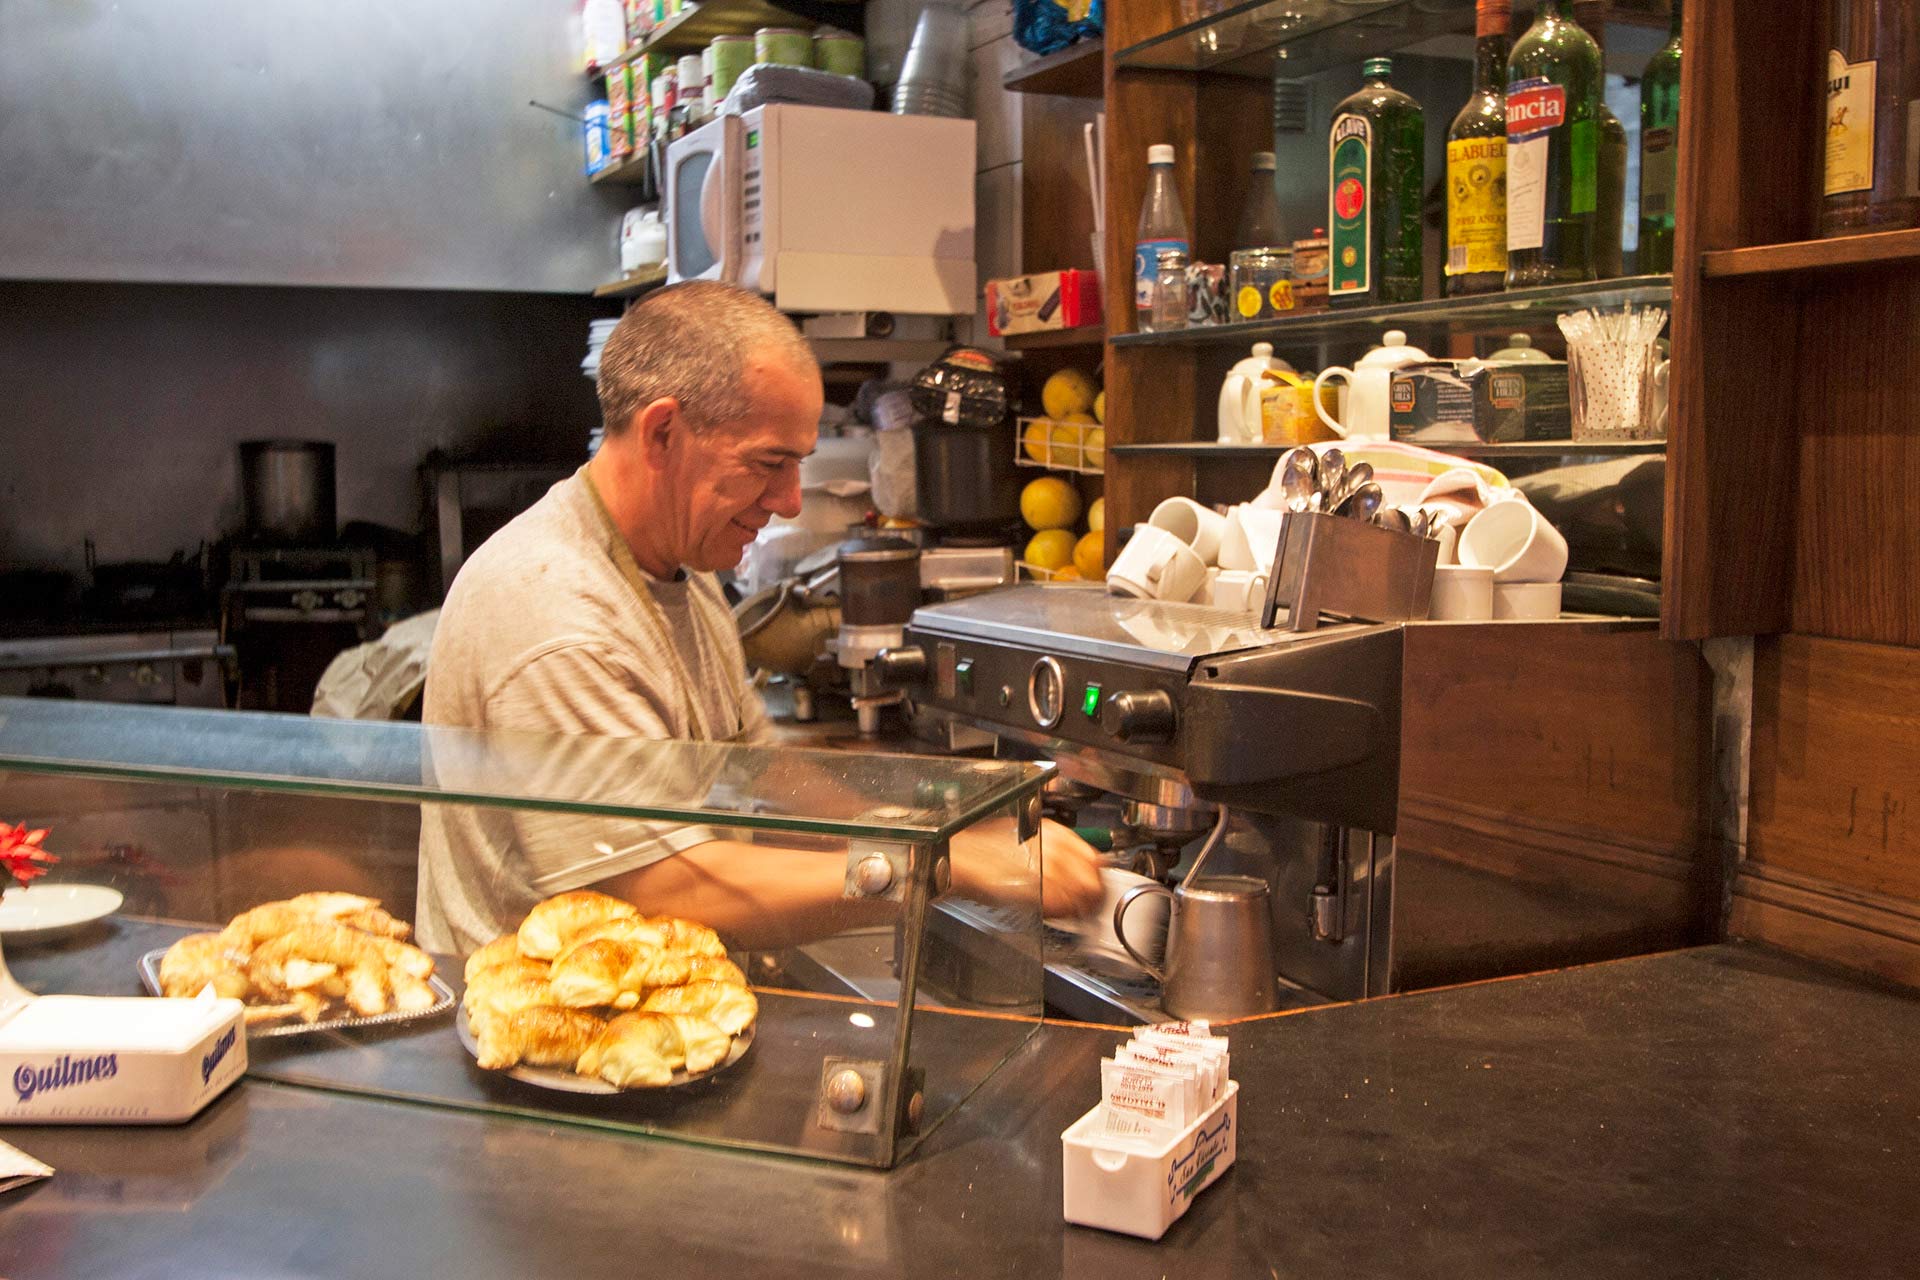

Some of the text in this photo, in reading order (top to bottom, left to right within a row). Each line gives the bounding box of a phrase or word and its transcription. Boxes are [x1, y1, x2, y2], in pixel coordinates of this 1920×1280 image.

[1393, 383, 1410, 393] GREEN
[1494, 378, 1520, 389] GREEN
[1394, 392, 1411, 402] HILLS
[1495, 387, 1520, 398] HILLS
[202, 1024, 236, 1087] Quilmes
[13, 1053, 118, 1104] Quilmes
